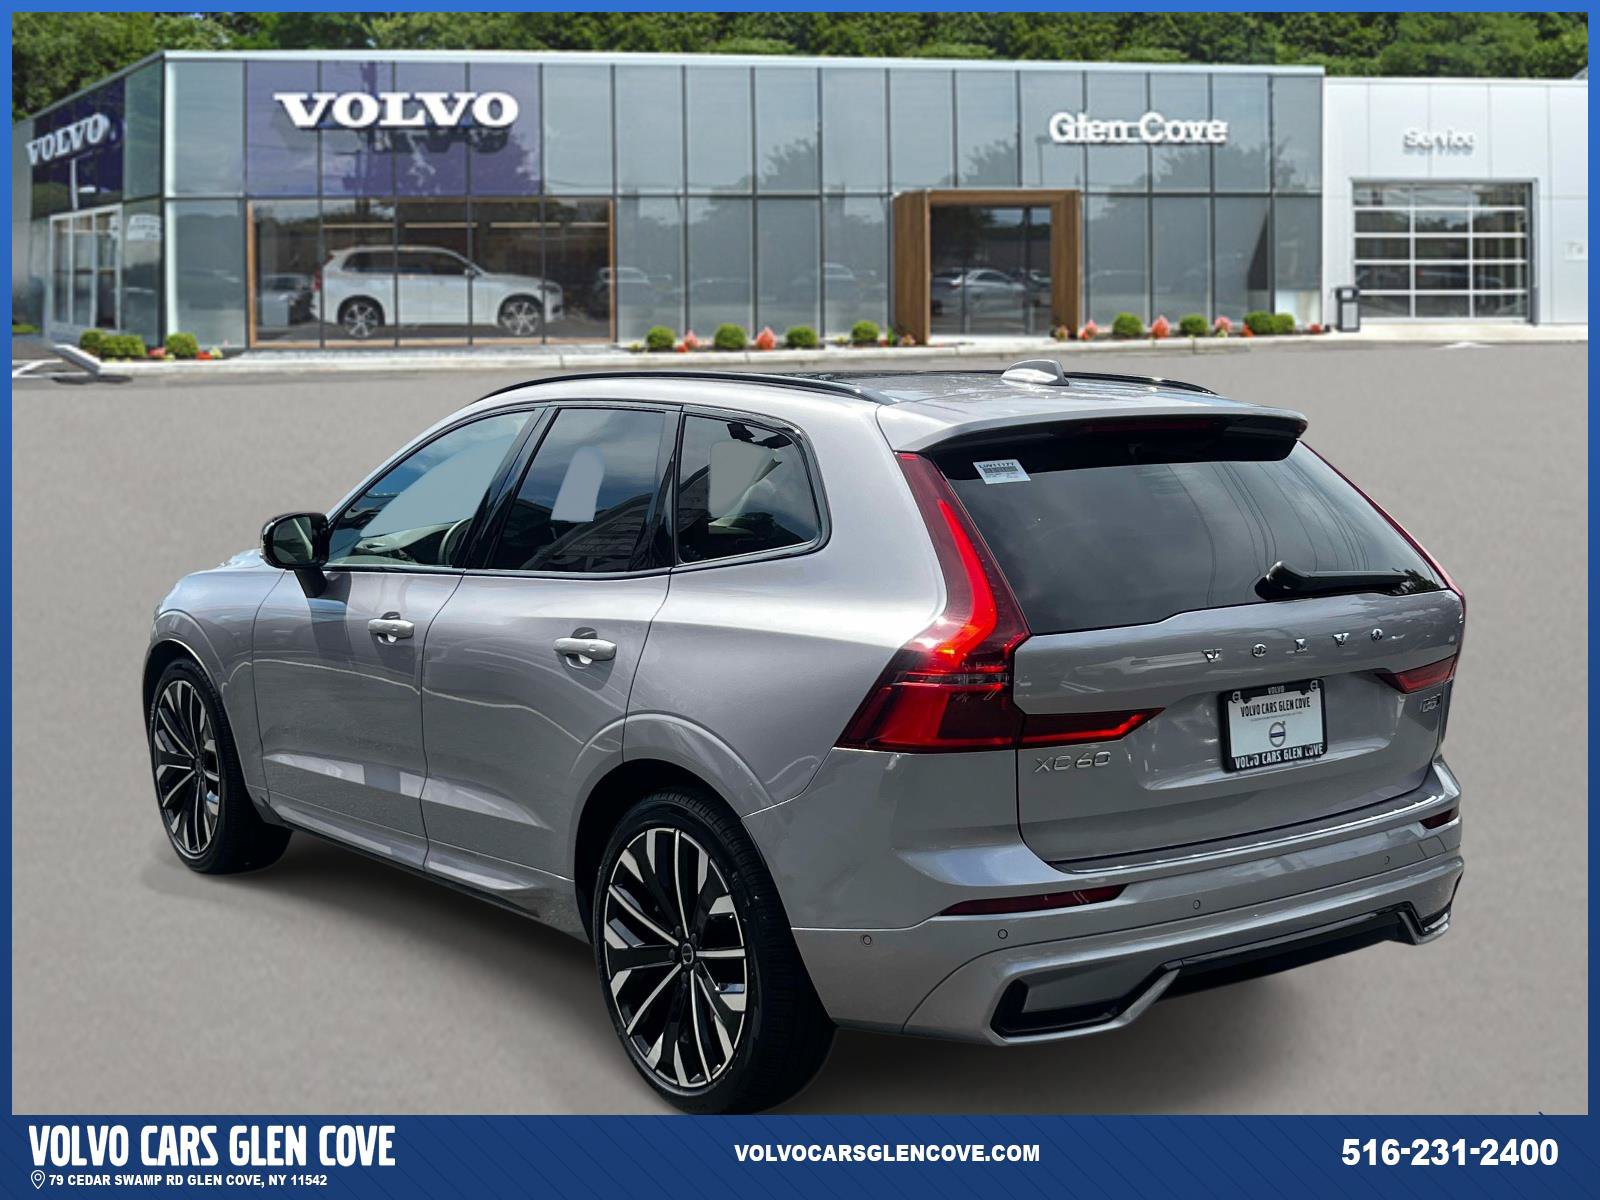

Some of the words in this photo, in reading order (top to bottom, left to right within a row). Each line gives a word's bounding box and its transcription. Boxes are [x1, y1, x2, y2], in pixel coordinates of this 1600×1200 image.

[275, 92, 519, 127] VOLVO
[25, 113, 110, 165] VOLVO
[1049, 111, 1129, 143] Glen
[1139, 111, 1228, 143] Cove
[1402, 128, 1476, 153] Service
[1201, 627, 1385, 663] VOLVO
[1240, 703, 1260, 717] VOLVO
[1262, 701, 1278, 715] CARS
[1279, 698, 1295, 712] GLEN
[1295, 697, 1311, 709] COVE
[1034, 750, 1112, 773] XC60
[1262, 750, 1281, 765] CARS
[1283, 746, 1302, 760] GLEN
